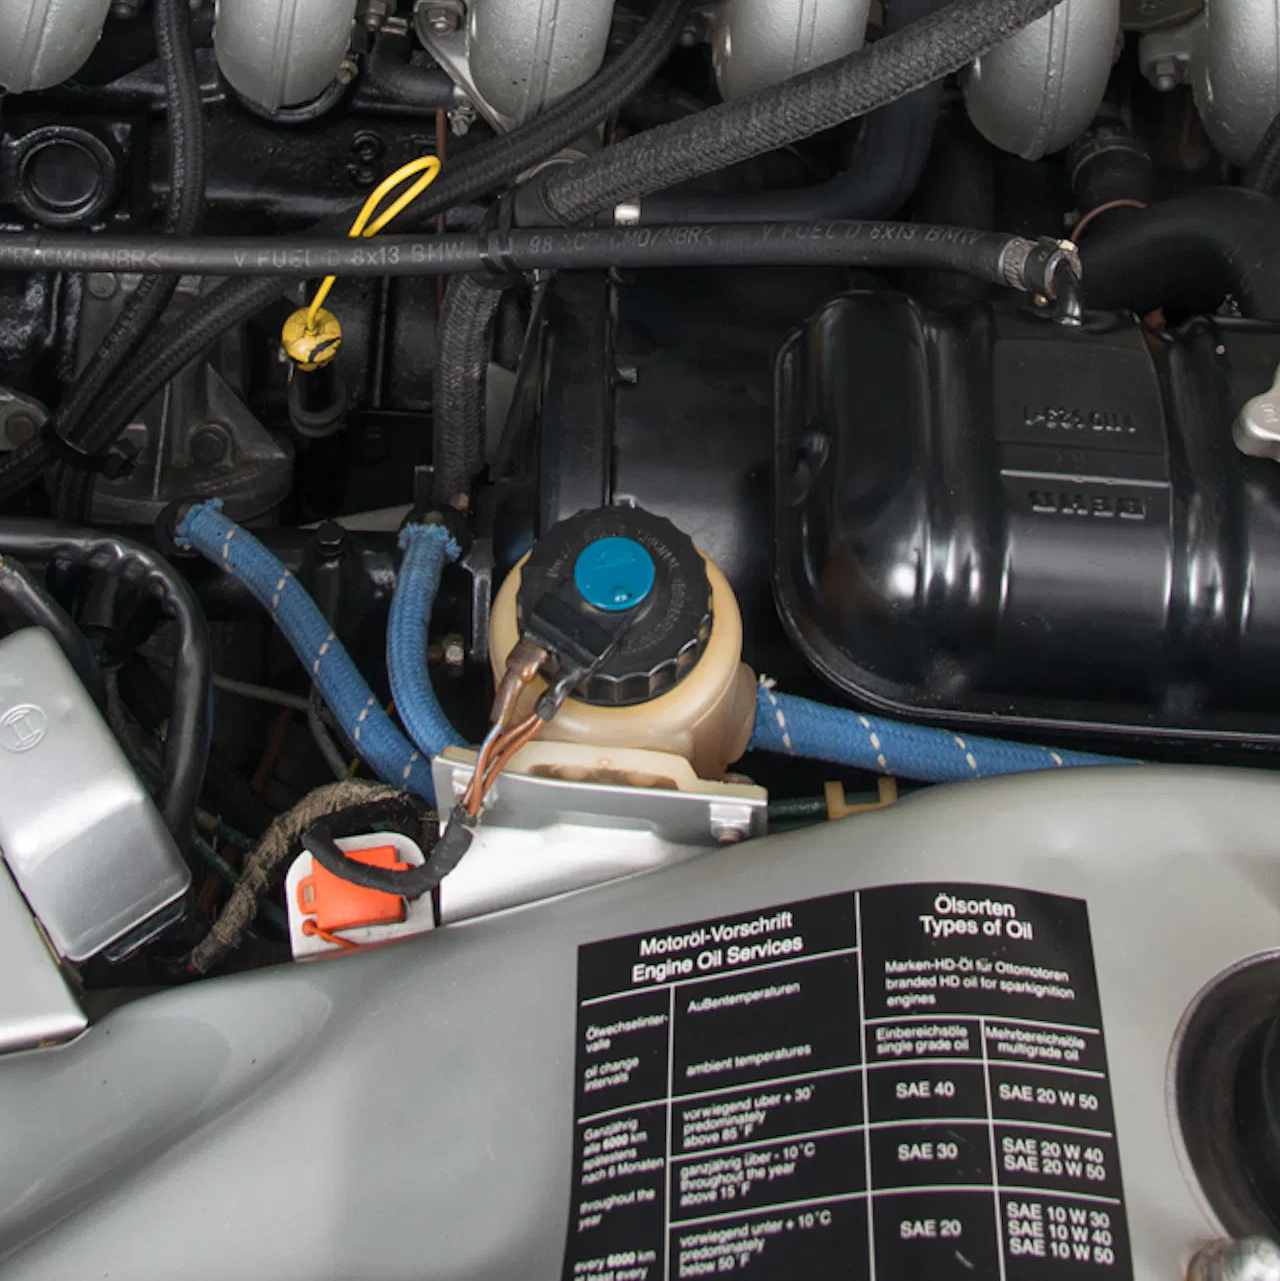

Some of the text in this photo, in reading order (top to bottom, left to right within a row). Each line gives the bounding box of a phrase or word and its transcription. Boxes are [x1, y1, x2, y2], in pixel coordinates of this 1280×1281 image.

[934, 892, 1016, 919] Ölsorten
[639, 911, 793, 957] Motoröl-Vorschrift
[919, 915, 1034, 941] Types of Oil
[632, 935, 803, 984] Engine Oil Services
[885, 954, 974, 975] Marken-HD-Öl
[995, 959, 1070, 983] Ottomotoren
[687, 981, 801, 1014] Außentemperaturen
[885, 969, 1075, 1000] branded HD oil for sparkignition
[886, 992, 937, 1009] engines
[586, 1037, 611, 1054] valle
[875, 1024, 968, 1043] Einbereichsöle
[876, 1037, 969, 1057] single grade oil
[985, 1026, 1086, 1051] Mehrbereichsöle
[686, 1043, 812, 1078] ambient temperatures
[998, 1040, 1080, 1063] multigrade oil
[584, 1055, 639, 1081] oil change
[895, 1080, 955, 1100] SAE 40
[999, 1083, 1099, 1111] SAE 20 W 50
[682, 1097, 752, 1122] vorwiegend
[630, 1129, 648, 1145] km
[683, 1110, 767, 1137] predominately
[683, 1130, 719, 1149] above
[897, 1142, 959, 1161] SAE 30
[1002, 1136, 1104, 1165] SAE 20 W 40
[581, 1168, 606, 1186] nach
[617, 1156, 665, 1177] Monaten
[680, 1161, 796, 1193] throughout the year
[1004, 1154, 1106, 1182] SAE 20 W 50
[580, 1187, 656, 1216] throughout the
[680, 1187, 717, 1208] above
[578, 1212, 604, 1234] year
[900, 1218, 962, 1239] SAE 20
[1006, 1201, 1110, 1229] SAE 10 W 30
[680, 1222, 749, 1248] vorwiegend
[751, 1216, 783, 1236] unter
[1007, 1219, 1112, 1247] SAE 10 W 40
[637, 1249, 656, 1264] km
[679, 1236, 766, 1264] predominately
[1009, 1237, 1114, 1266] SAE 10 W 50
[679, 1258, 716, 1278] below
